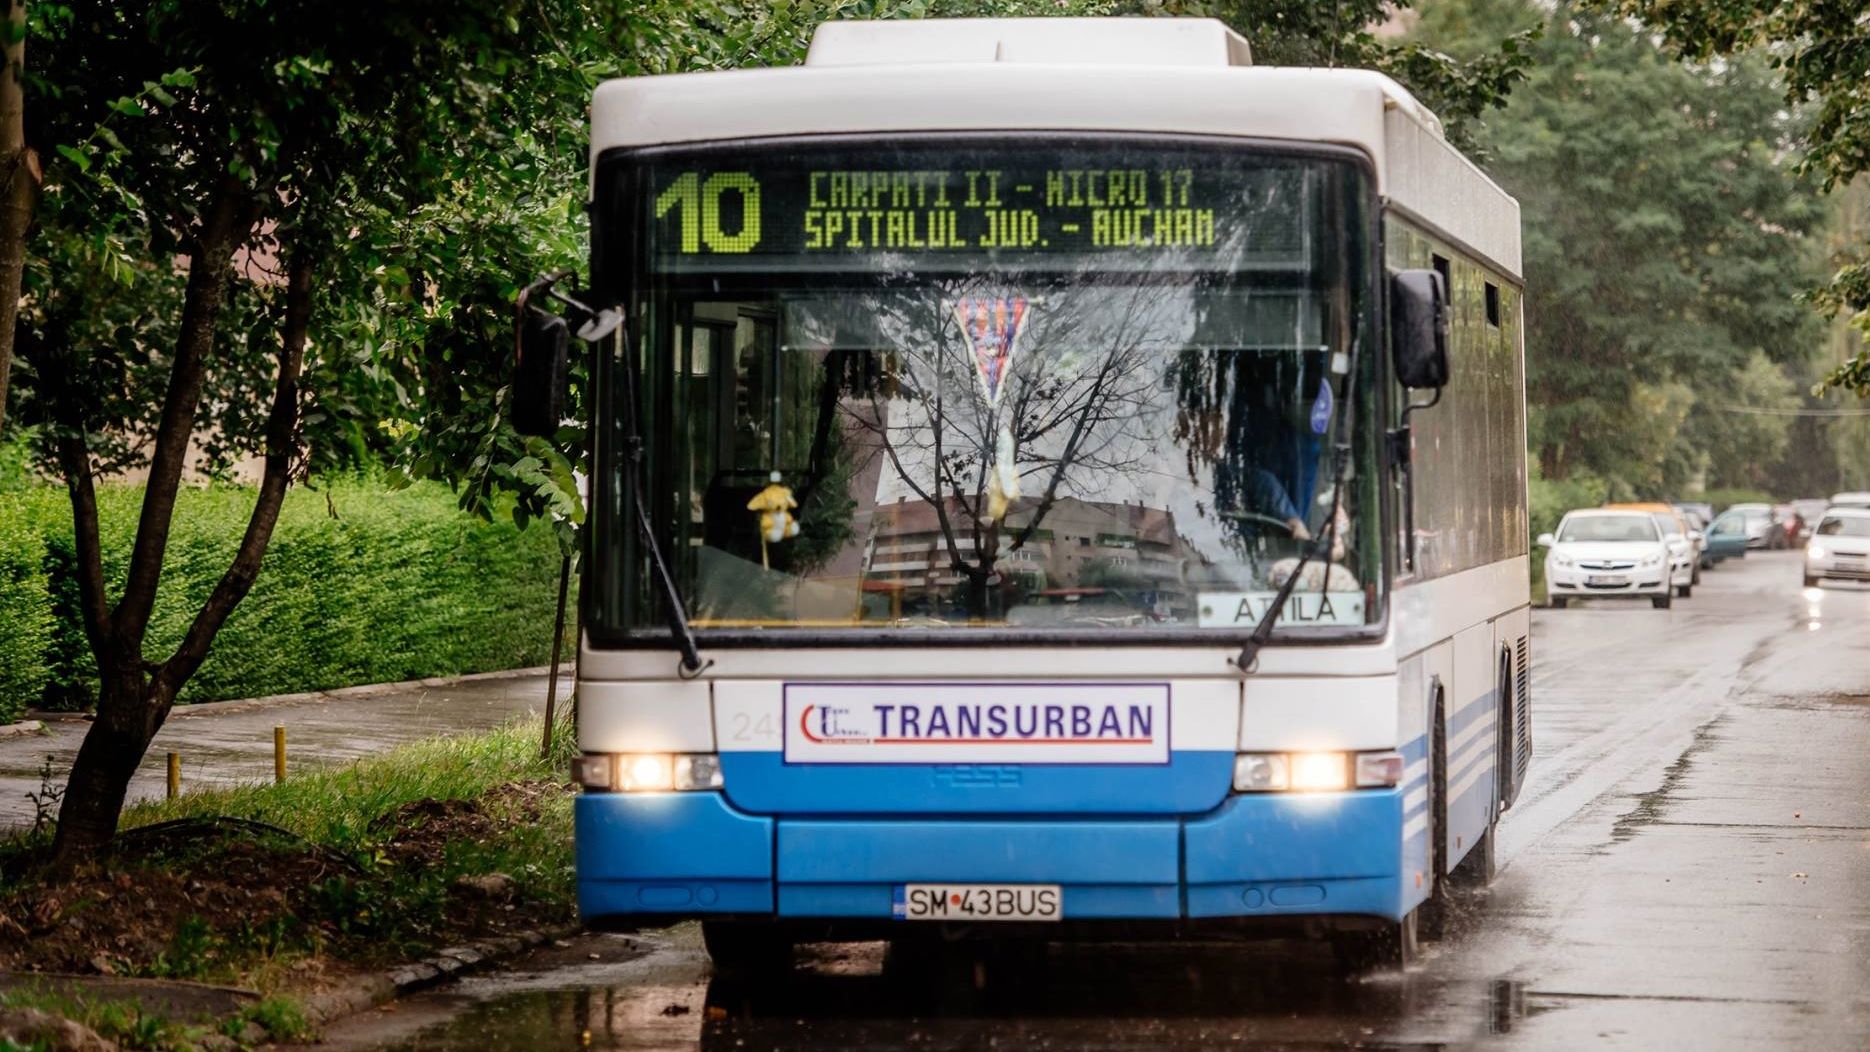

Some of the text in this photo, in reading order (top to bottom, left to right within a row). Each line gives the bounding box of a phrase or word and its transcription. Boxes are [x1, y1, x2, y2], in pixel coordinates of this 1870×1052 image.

[810, 171, 950, 208] CARPATI
[965, 171, 1002, 208] II
[1046, 170, 1147, 207] MICRO
[1160, 169, 1193, 206] 17
[656, 172, 760, 253] 10
[805, 210, 966, 248] SPITALUL
[980, 210, 1048, 247] JUD.
[873, 704, 1154, 739] TRANSURBAN
[910, 889, 948, 916] SM
